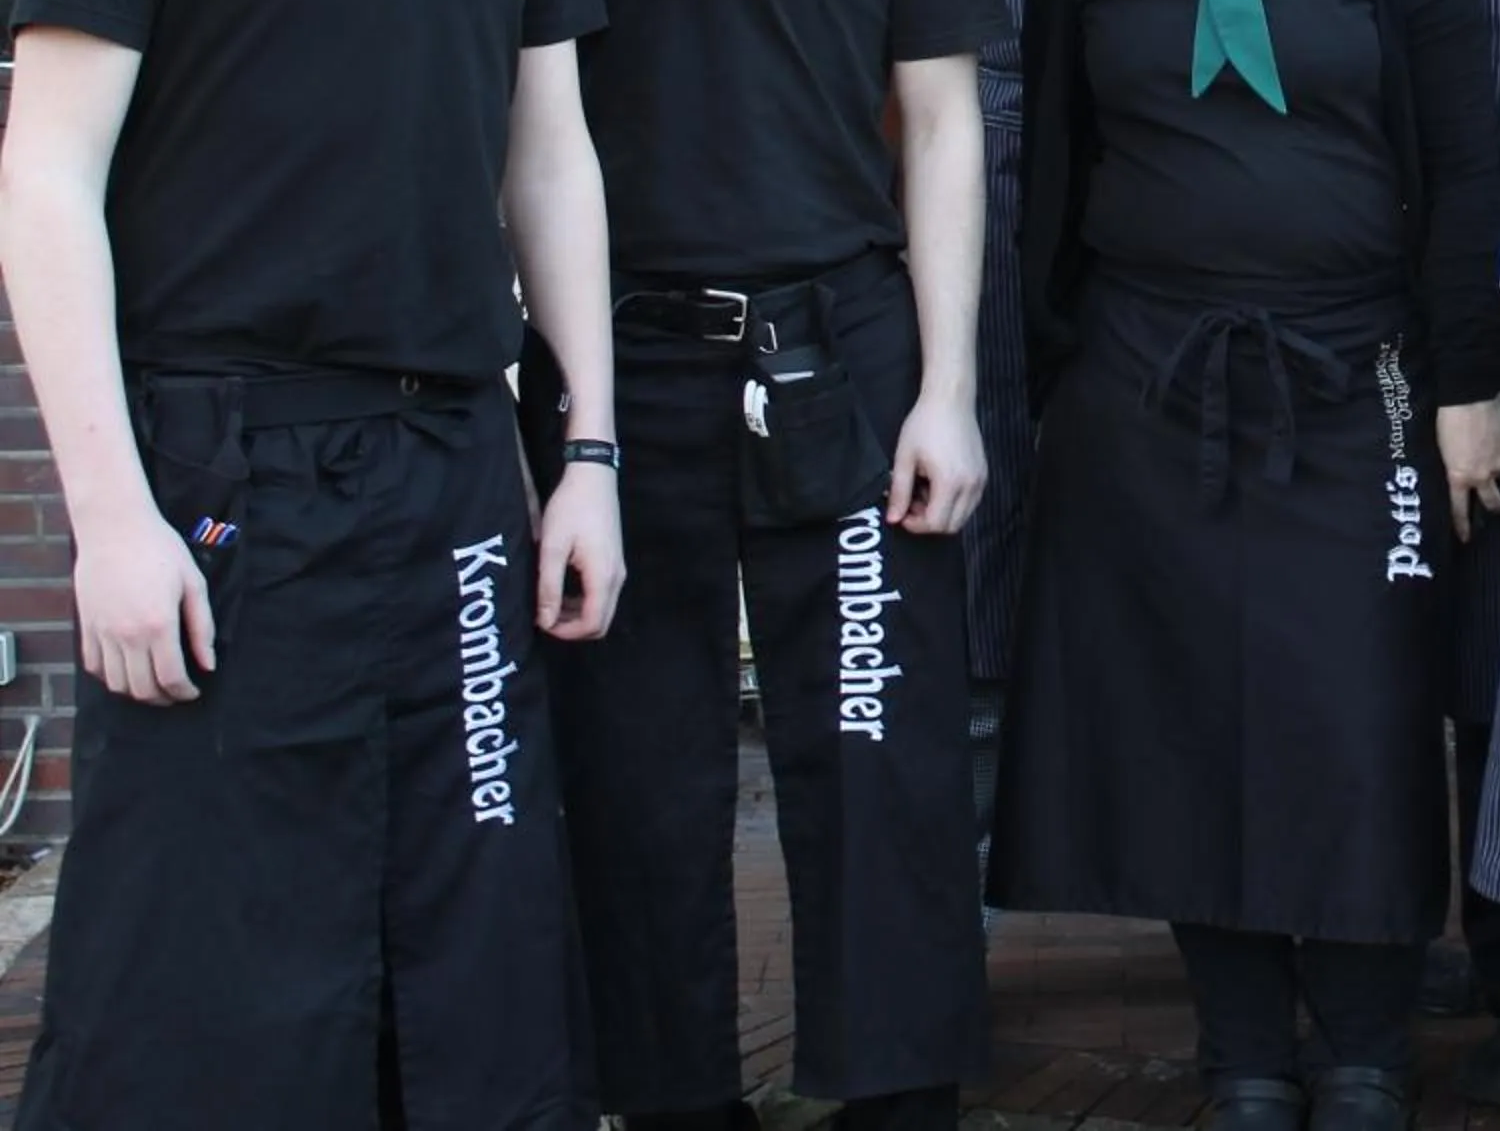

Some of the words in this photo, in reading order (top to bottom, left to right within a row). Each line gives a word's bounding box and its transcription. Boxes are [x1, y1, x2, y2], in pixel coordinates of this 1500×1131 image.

[837, 506, 904, 742] rombacher
[1386, 465, 1434, 582] Pott's
[453, 533, 519, 825] Krombacher
